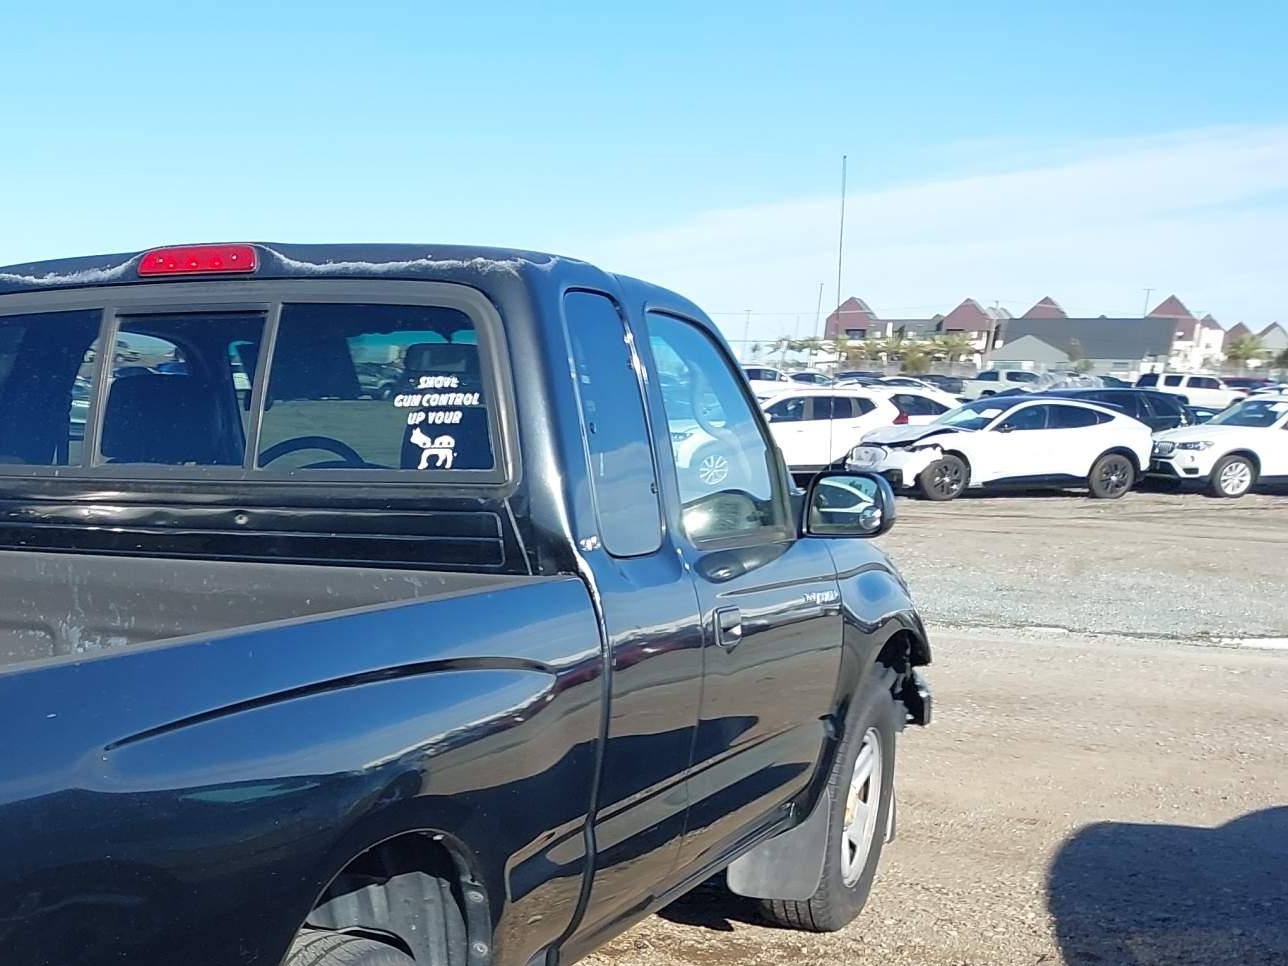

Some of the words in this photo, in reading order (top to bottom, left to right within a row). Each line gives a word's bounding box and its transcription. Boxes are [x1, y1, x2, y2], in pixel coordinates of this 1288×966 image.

[394, 394, 422, 407] GUN
[422, 392, 480, 407] CONTROL
[408, 411, 426, 425] UP
[428, 410, 463, 424] YOUR
